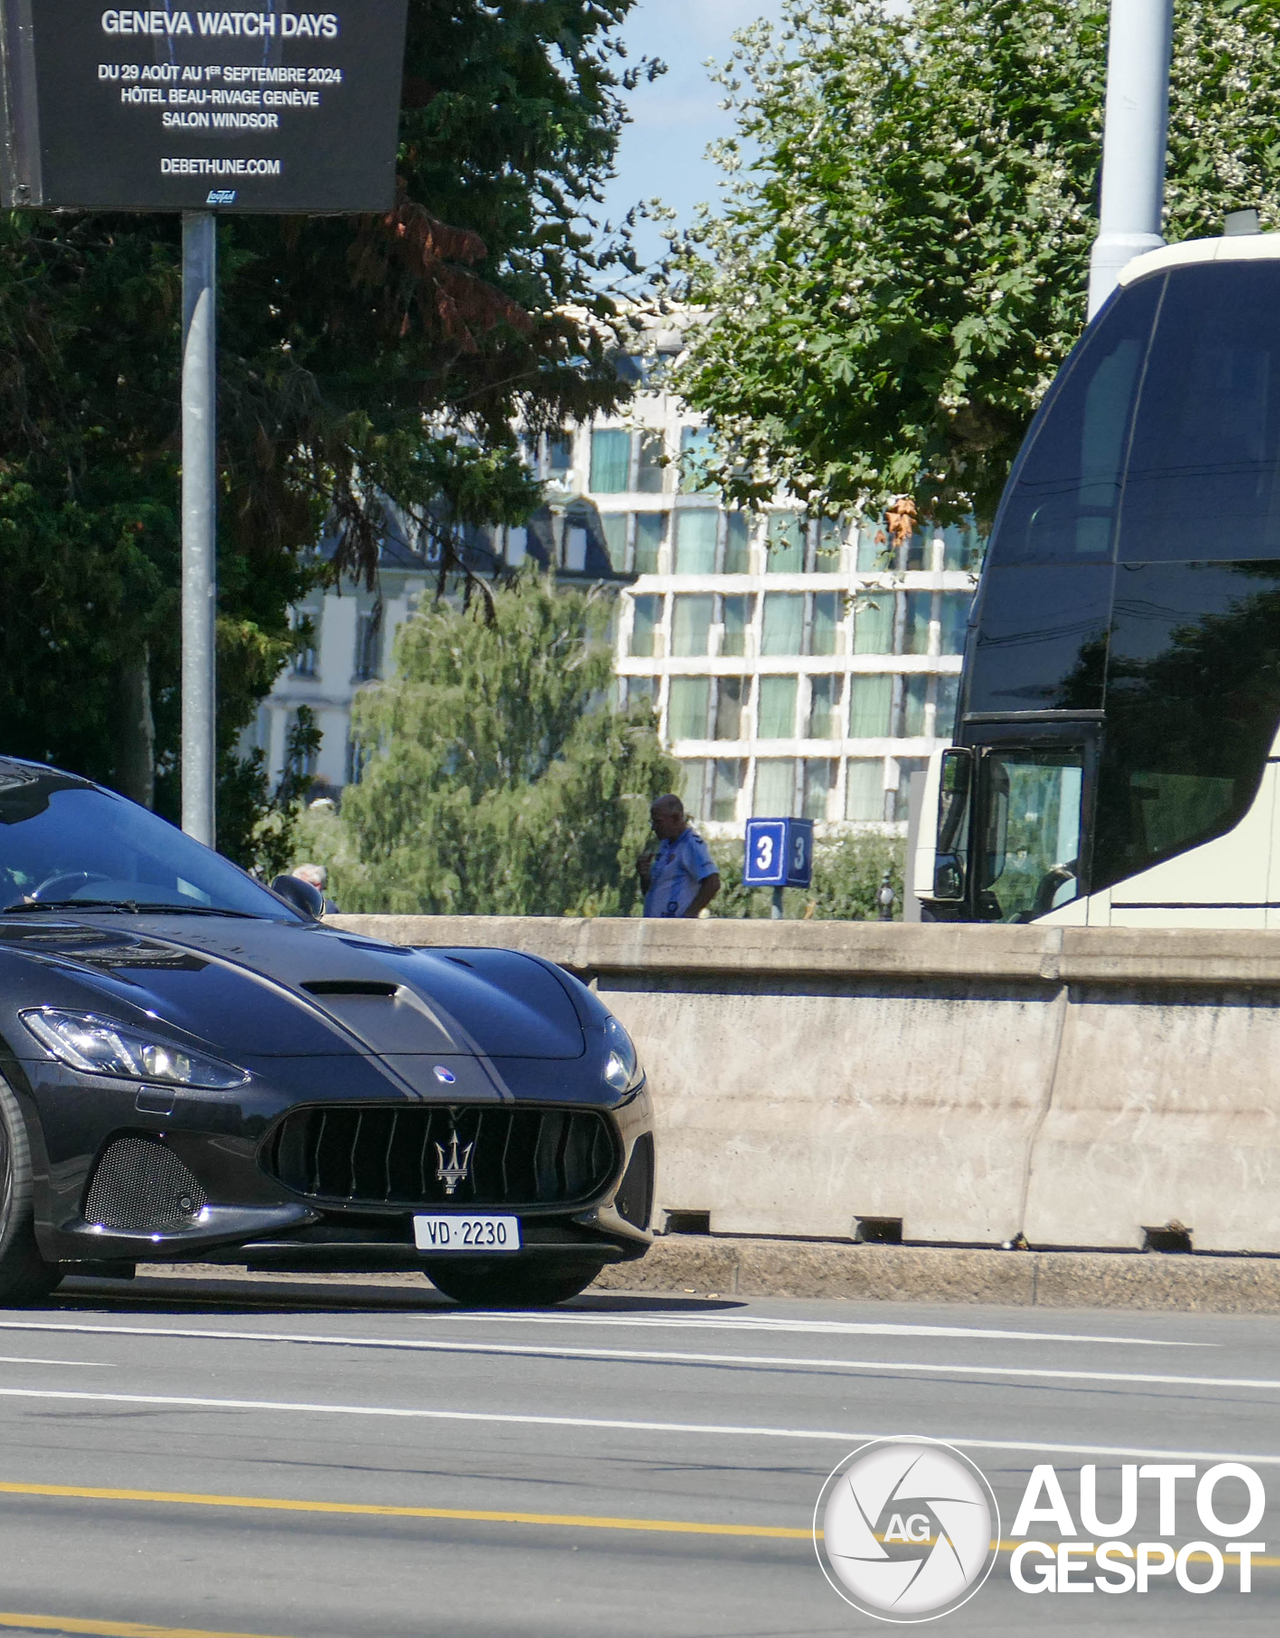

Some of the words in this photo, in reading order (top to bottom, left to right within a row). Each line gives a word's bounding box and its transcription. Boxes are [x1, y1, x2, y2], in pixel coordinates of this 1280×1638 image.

[101, 9, 193, 35] GENEVA
[197, 11, 275, 36] WATCH
[280, 13, 338, 37] DAYS
[98, 64, 120, 81] DU
[121, 65, 140, 81] 29
[141, 62, 181, 82] AOÛT
[182, 66, 203, 82] AU
[223, 66, 306, 83] SEPTEMBRE
[307, 67, 343, 84] 2024
[121, 86, 167, 103] HÔTEL
[169, 88, 261, 105] BEAU-RIVAGE
[263, 88, 319, 106] GENÈVE
[162, 112, 210, 128] SALON
[212, 113, 279, 129] WINDSOR
[161, 158, 281, 175] DEBETHUNE.COM
[756, 835, 773, 870] 3
[793, 837, 805, 869] 3
